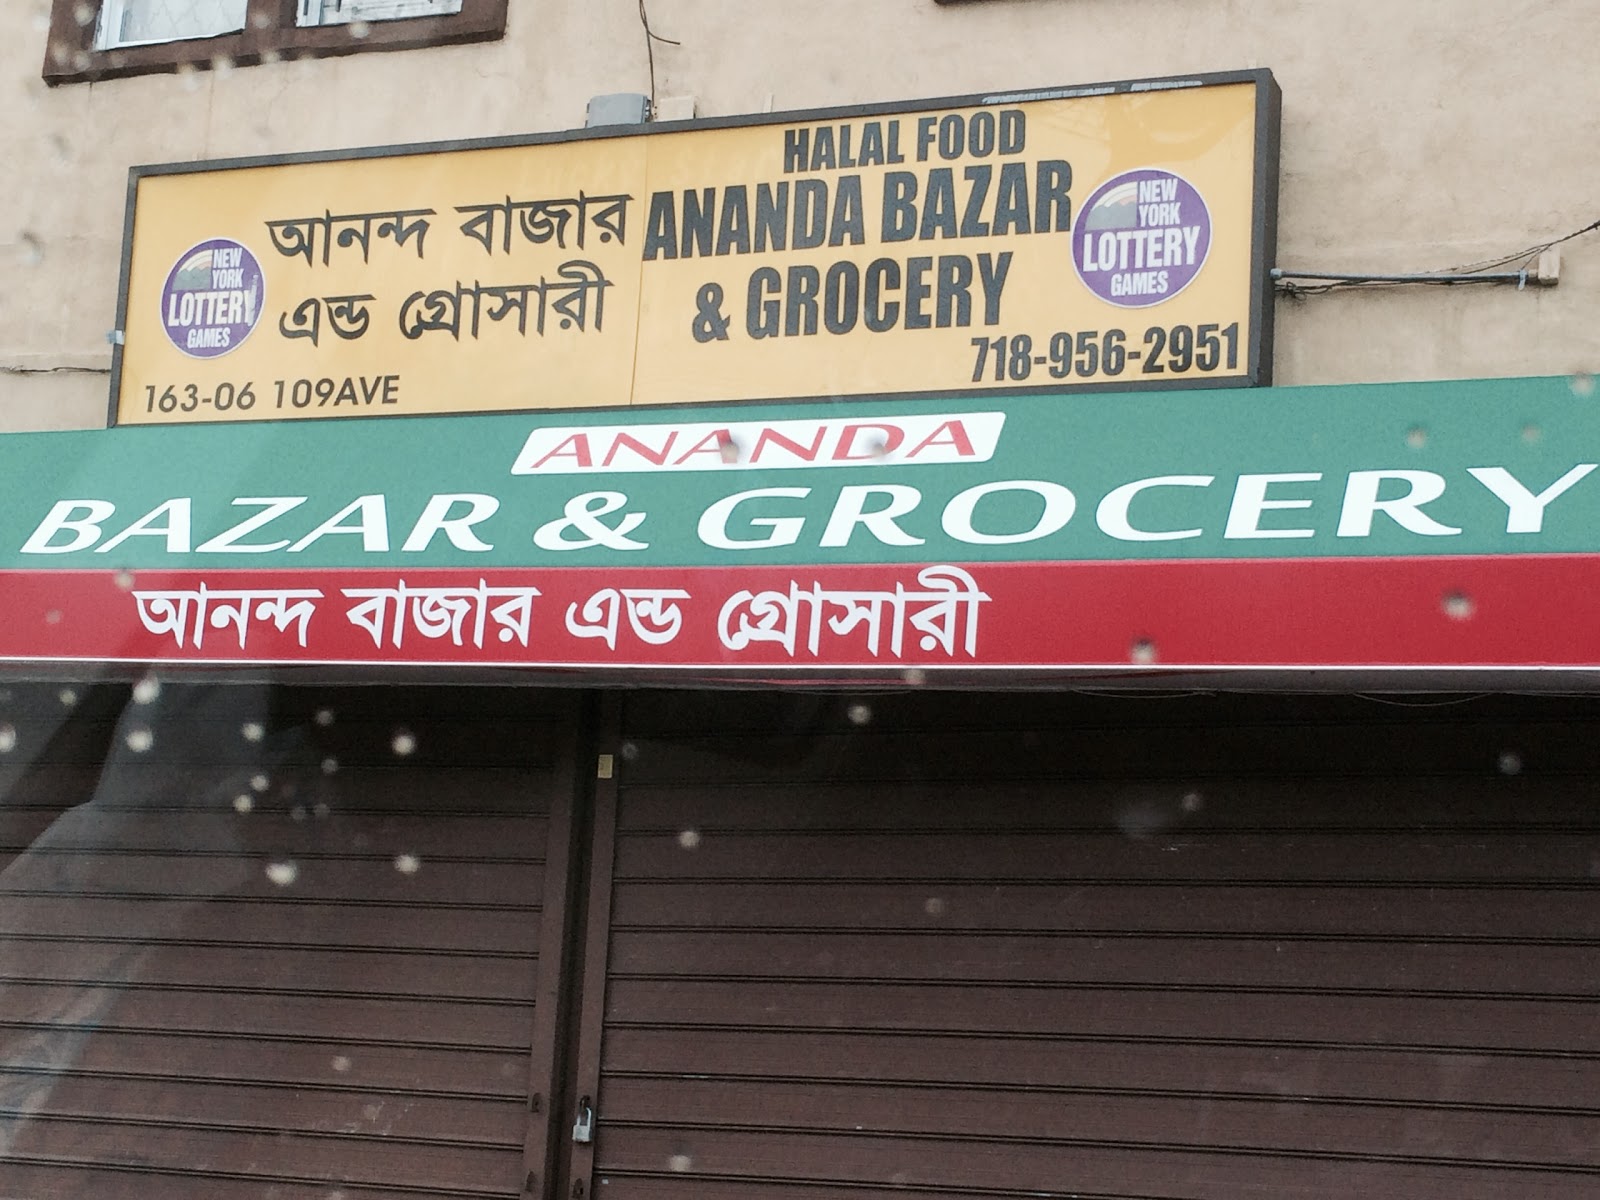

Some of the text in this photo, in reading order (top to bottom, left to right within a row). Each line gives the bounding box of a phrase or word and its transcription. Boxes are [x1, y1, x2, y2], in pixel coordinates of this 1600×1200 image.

[783, 109, 1026, 173] HALAL FOOD
[643, 159, 1072, 261] ANANDA BAZAR
[1138, 202, 1181, 227] YORK
[1139, 178, 1178, 203] NEW
[264, 190, 634, 268] আনন্দ বাজার
[1082, 225, 1201, 272] LOTTERY
[212, 268, 244, 290] YORK
[213, 247, 243, 269] NEW
[279, 260, 615, 348] এন্ড গ্রোসারী
[692, 251, 1013, 343] & GROCERY
[1110, 270, 1169, 297] GAMES
[187, 327, 231, 349] GAMES
[971, 322, 1239, 383] 718-956-2951
[145, 375, 400, 413] 163-06 109AVE
[530, 419, 976, 469] ANANDA
[20, 463, 1599, 555] BAZAR & GROCERY
[131, 563, 993, 658] আনন্দ বাজার এন্ড গ্রোসারী
